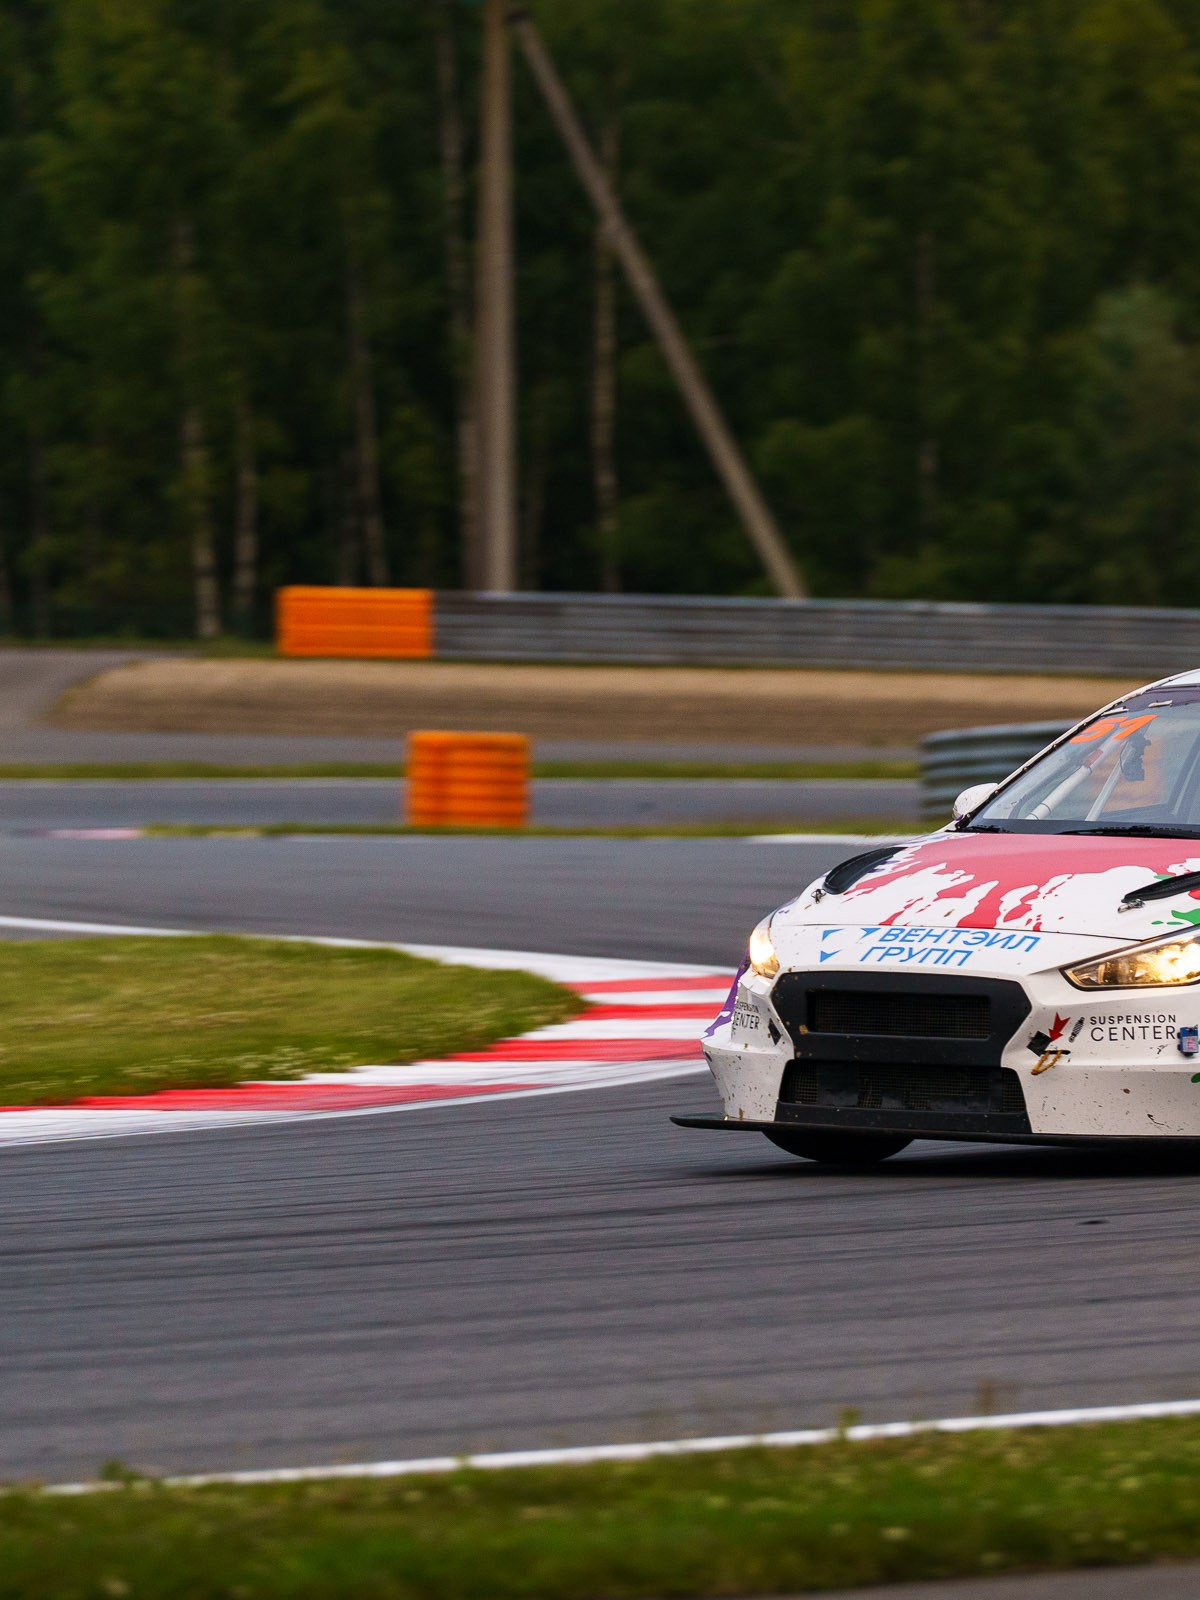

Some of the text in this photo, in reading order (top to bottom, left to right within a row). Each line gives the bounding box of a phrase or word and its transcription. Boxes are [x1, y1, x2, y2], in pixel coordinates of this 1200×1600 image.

[1069, 714, 1158, 744] 51
[878, 927, 1041, 952] ВЕНТЭИЛ
[859, 946, 974, 966] ГРУПП
[1090, 1014, 1176, 1025] SUSPENSION
[1090, 1025, 1176, 1042] CENTER
